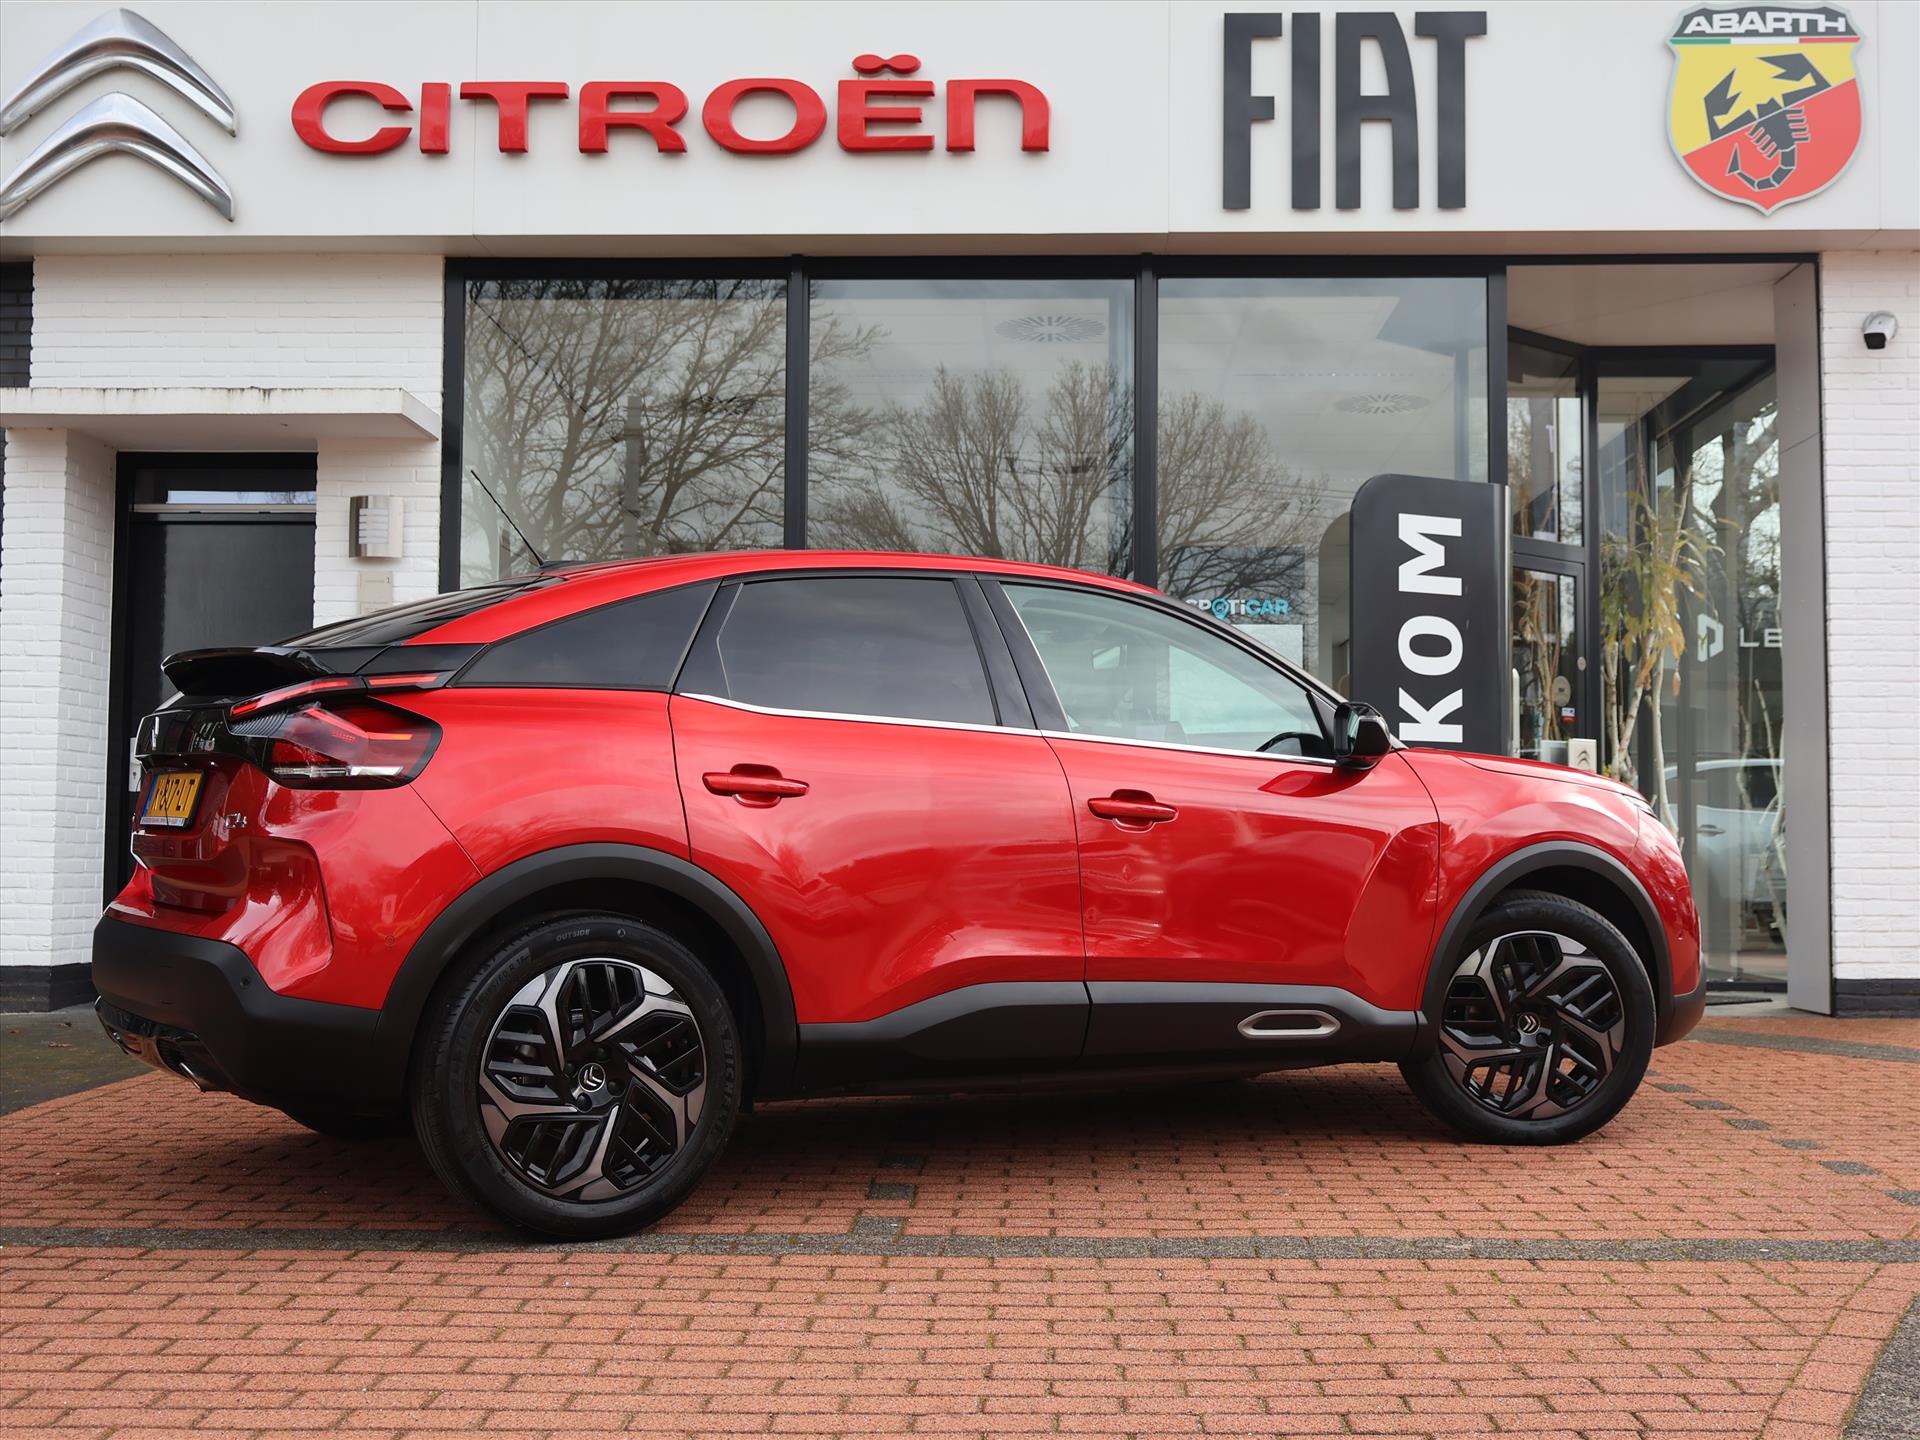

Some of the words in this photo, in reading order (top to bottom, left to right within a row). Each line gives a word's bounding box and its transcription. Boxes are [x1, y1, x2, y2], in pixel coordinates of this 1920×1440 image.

[1683, 10, 1846, 34] ABARTH
[292, 54, 1050, 155] CITROËN
[1223, 12, 1486, 210] FIAT
[1398, 512, 1463, 743] KOM
[555, 928, 591, 942] OUTSIDE
